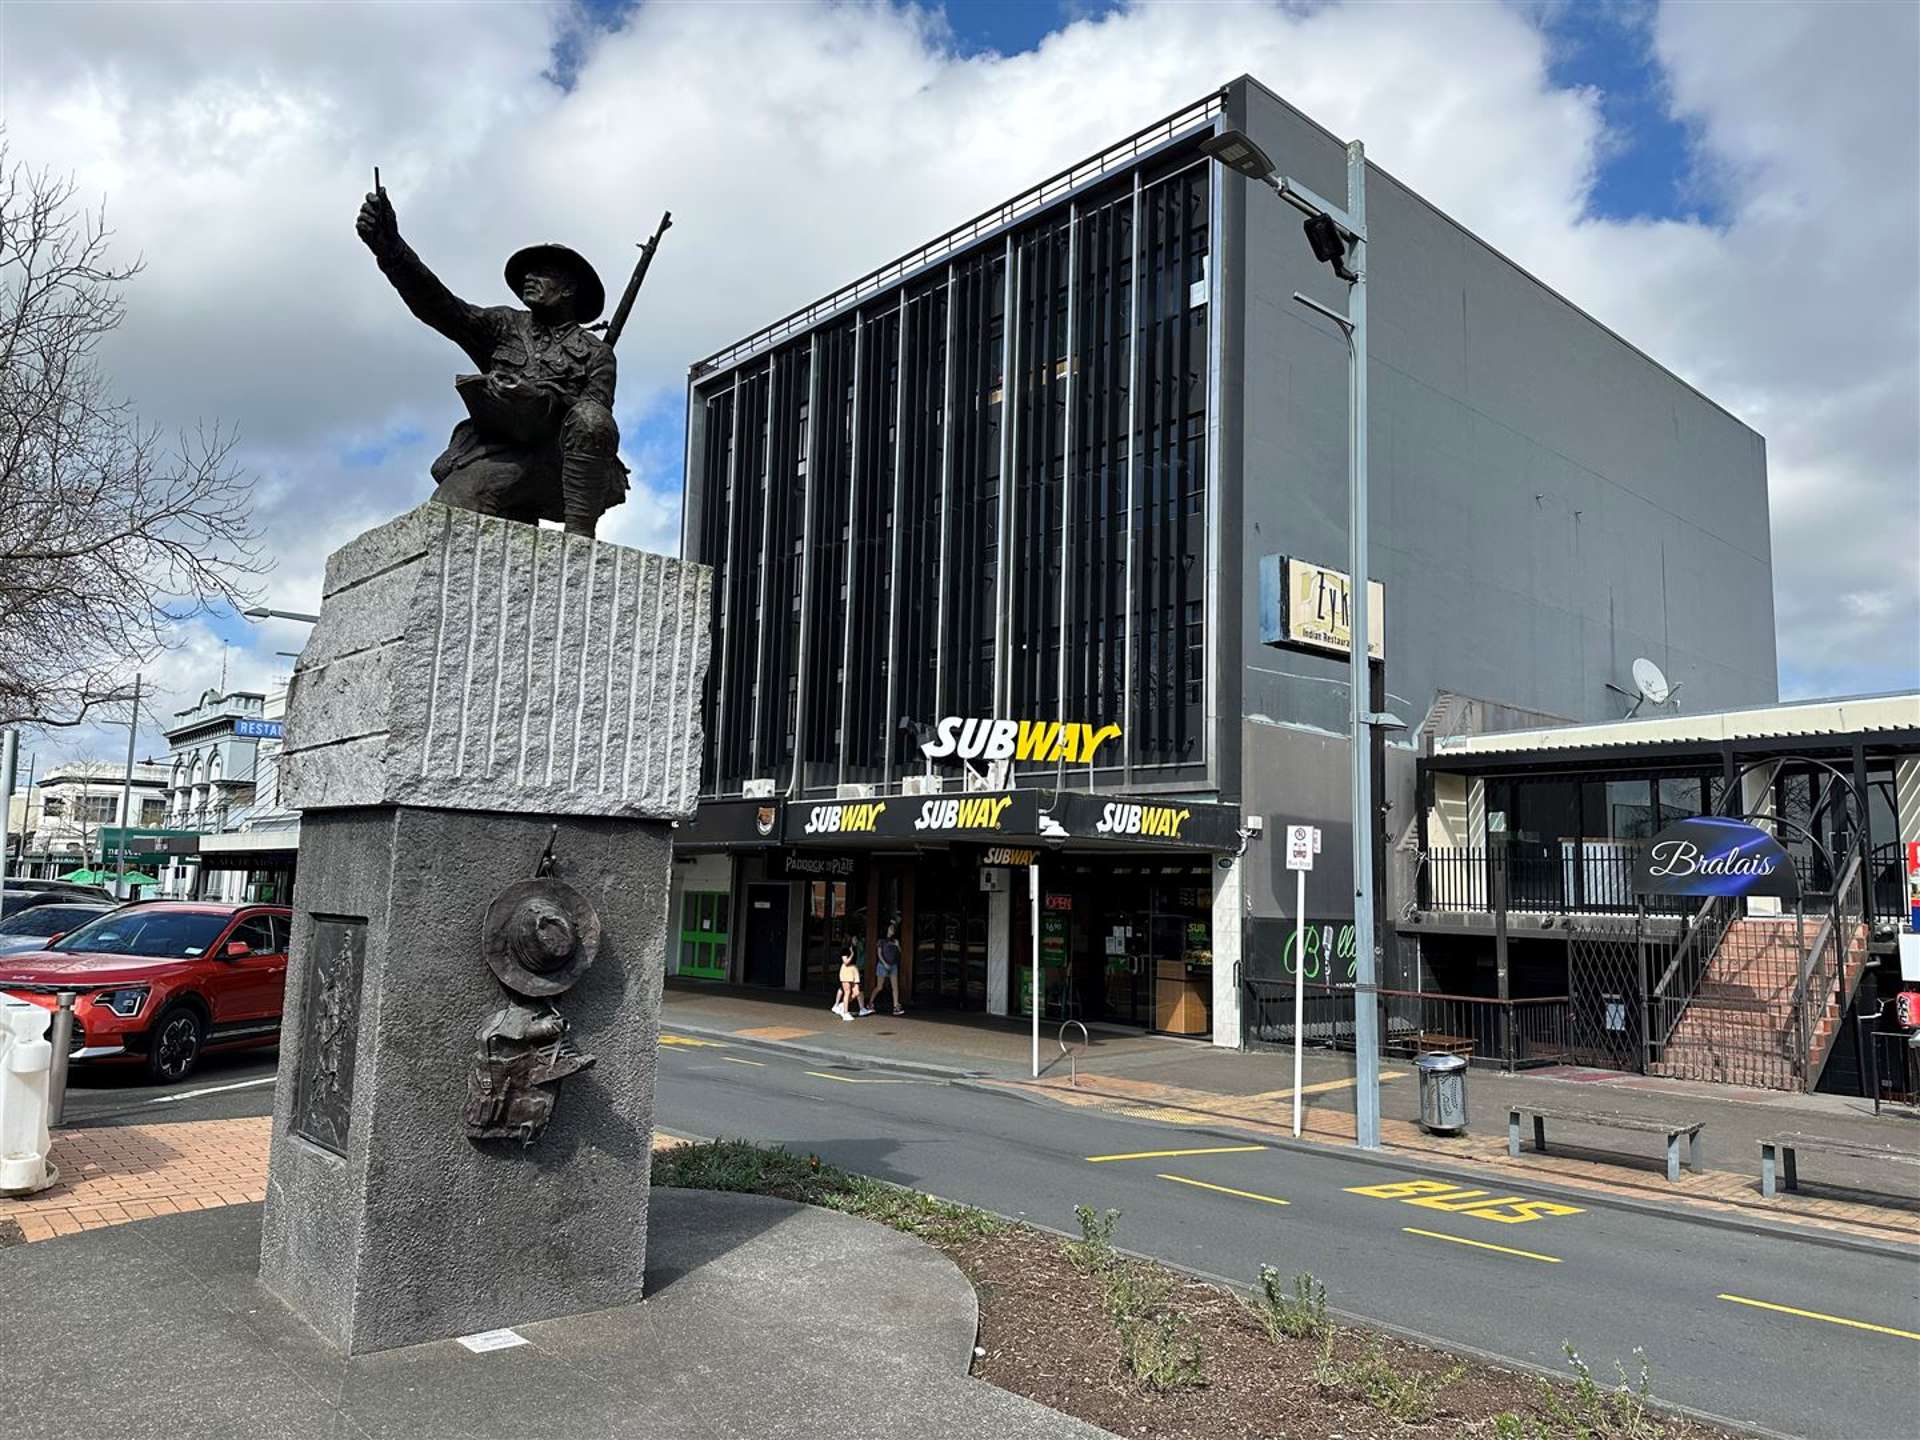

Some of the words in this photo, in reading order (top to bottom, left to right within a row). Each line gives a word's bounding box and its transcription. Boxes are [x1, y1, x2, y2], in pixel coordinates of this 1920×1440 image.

[1317, 571, 1349, 633] Zyk
[1303, 627, 1322, 641] Indian
[1323, 631, 1350, 648] Restaura
[240, 721, 283, 736] RESTA
[921, 717, 1122, 763] SUBWAY
[805, 802, 886, 834] SUBWAY
[914, 795, 1012, 830] SUBWAY
[1096, 802, 1190, 837] SUBWAY
[984, 847, 1039, 866] SUBWAY
[1649, 840, 1776, 877] Bralais
[1046, 896, 1072, 910] OPEN
[1342, 1179, 1587, 1224] BUS
